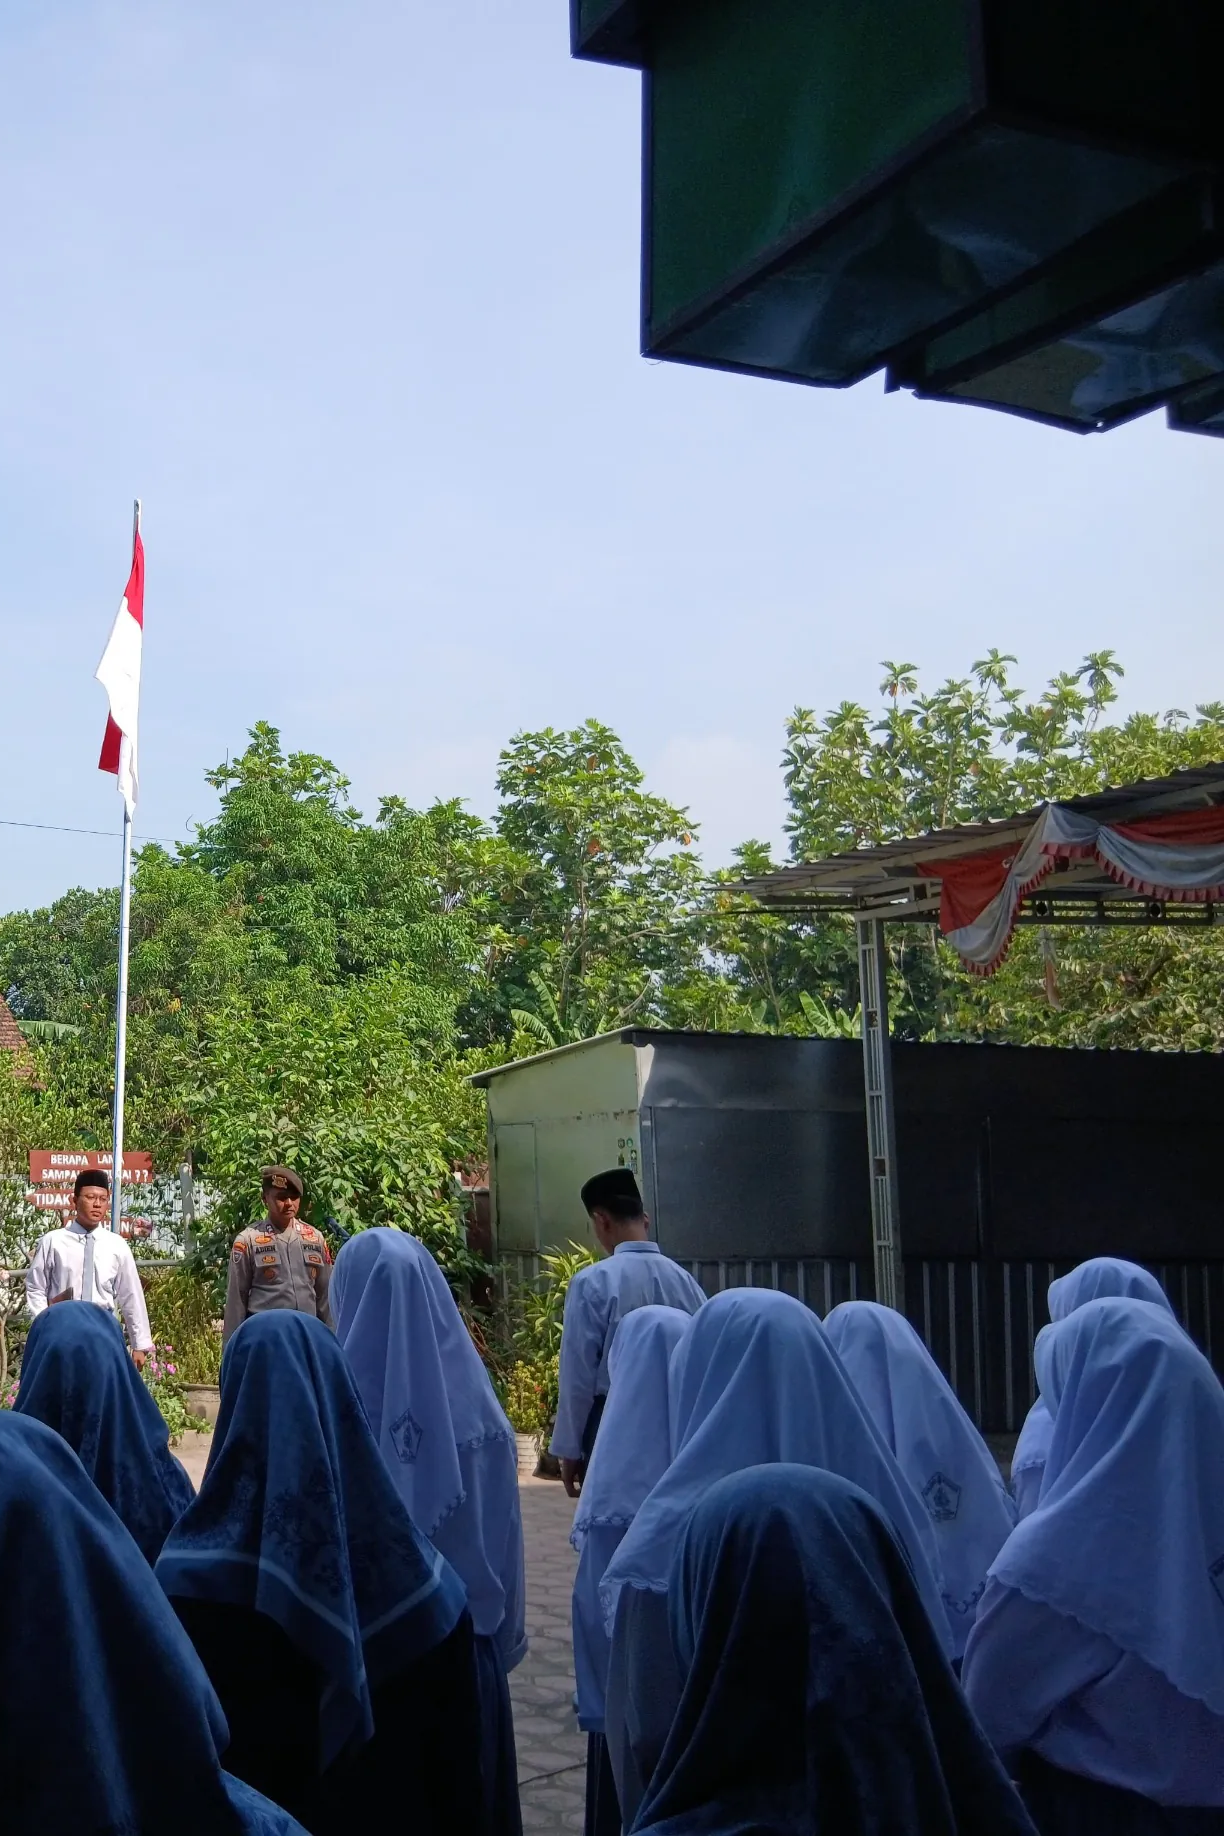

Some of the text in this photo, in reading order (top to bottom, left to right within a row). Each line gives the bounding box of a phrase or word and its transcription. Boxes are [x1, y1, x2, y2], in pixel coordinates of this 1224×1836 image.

[50, 1154, 88, 1165] BERAPA
[42, 1169, 84, 1180] SAMPA
[34, 1193, 71, 1205] TIDAK
